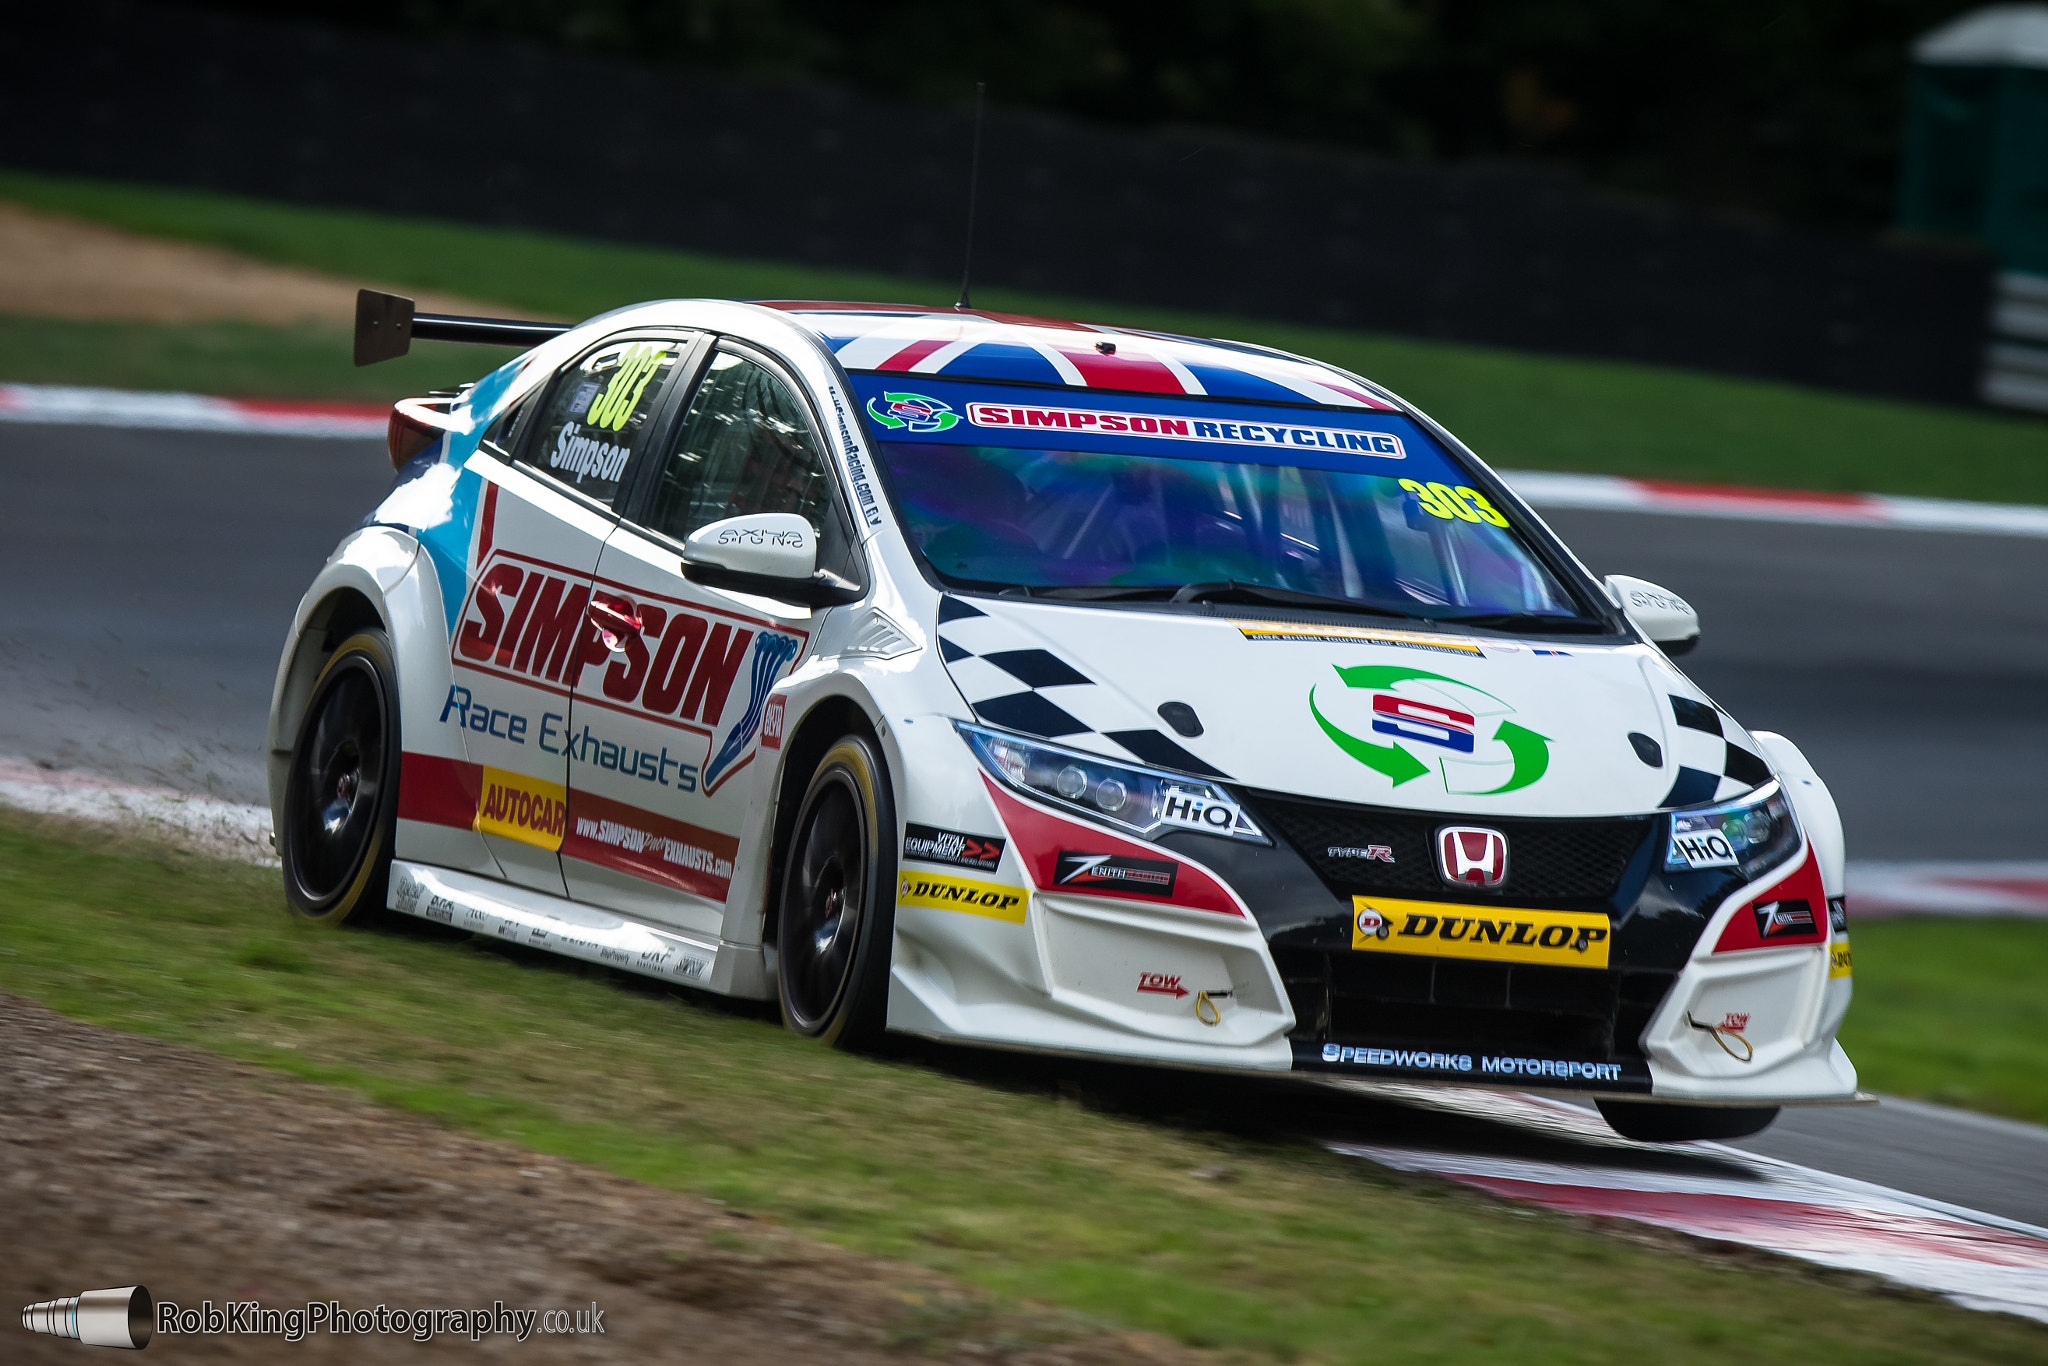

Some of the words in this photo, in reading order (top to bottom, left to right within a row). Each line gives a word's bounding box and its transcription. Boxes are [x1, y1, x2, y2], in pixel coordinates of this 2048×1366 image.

[586, 343, 667, 432] 303
[550, 421, 631, 484] Simpson
[977, 407, 1188, 436] SIMPSON
[1194, 421, 1397, 454] RECYCLING
[1398, 478, 1511, 528] 303
[459, 563, 754, 728] SIMPSON
[439, 684, 528, 745] Race
[538, 712, 700, 793] Exhausts
[481, 783, 567, 838] AUTOCAR
[1165, 796, 1233, 829] HiQ
[1327, 846, 1368, 860] TYPE
[1679, 836, 1734, 861] HiQ
[911, 880, 1020, 911] DUNLOP
[1397, 912, 1608, 953] DUNLOP
[1139, 972, 1182, 989] TOW
[1321, 1043, 1473, 1072] SPEEDWORKS
[1482, 1055, 1622, 1081] MOTORSPORT
